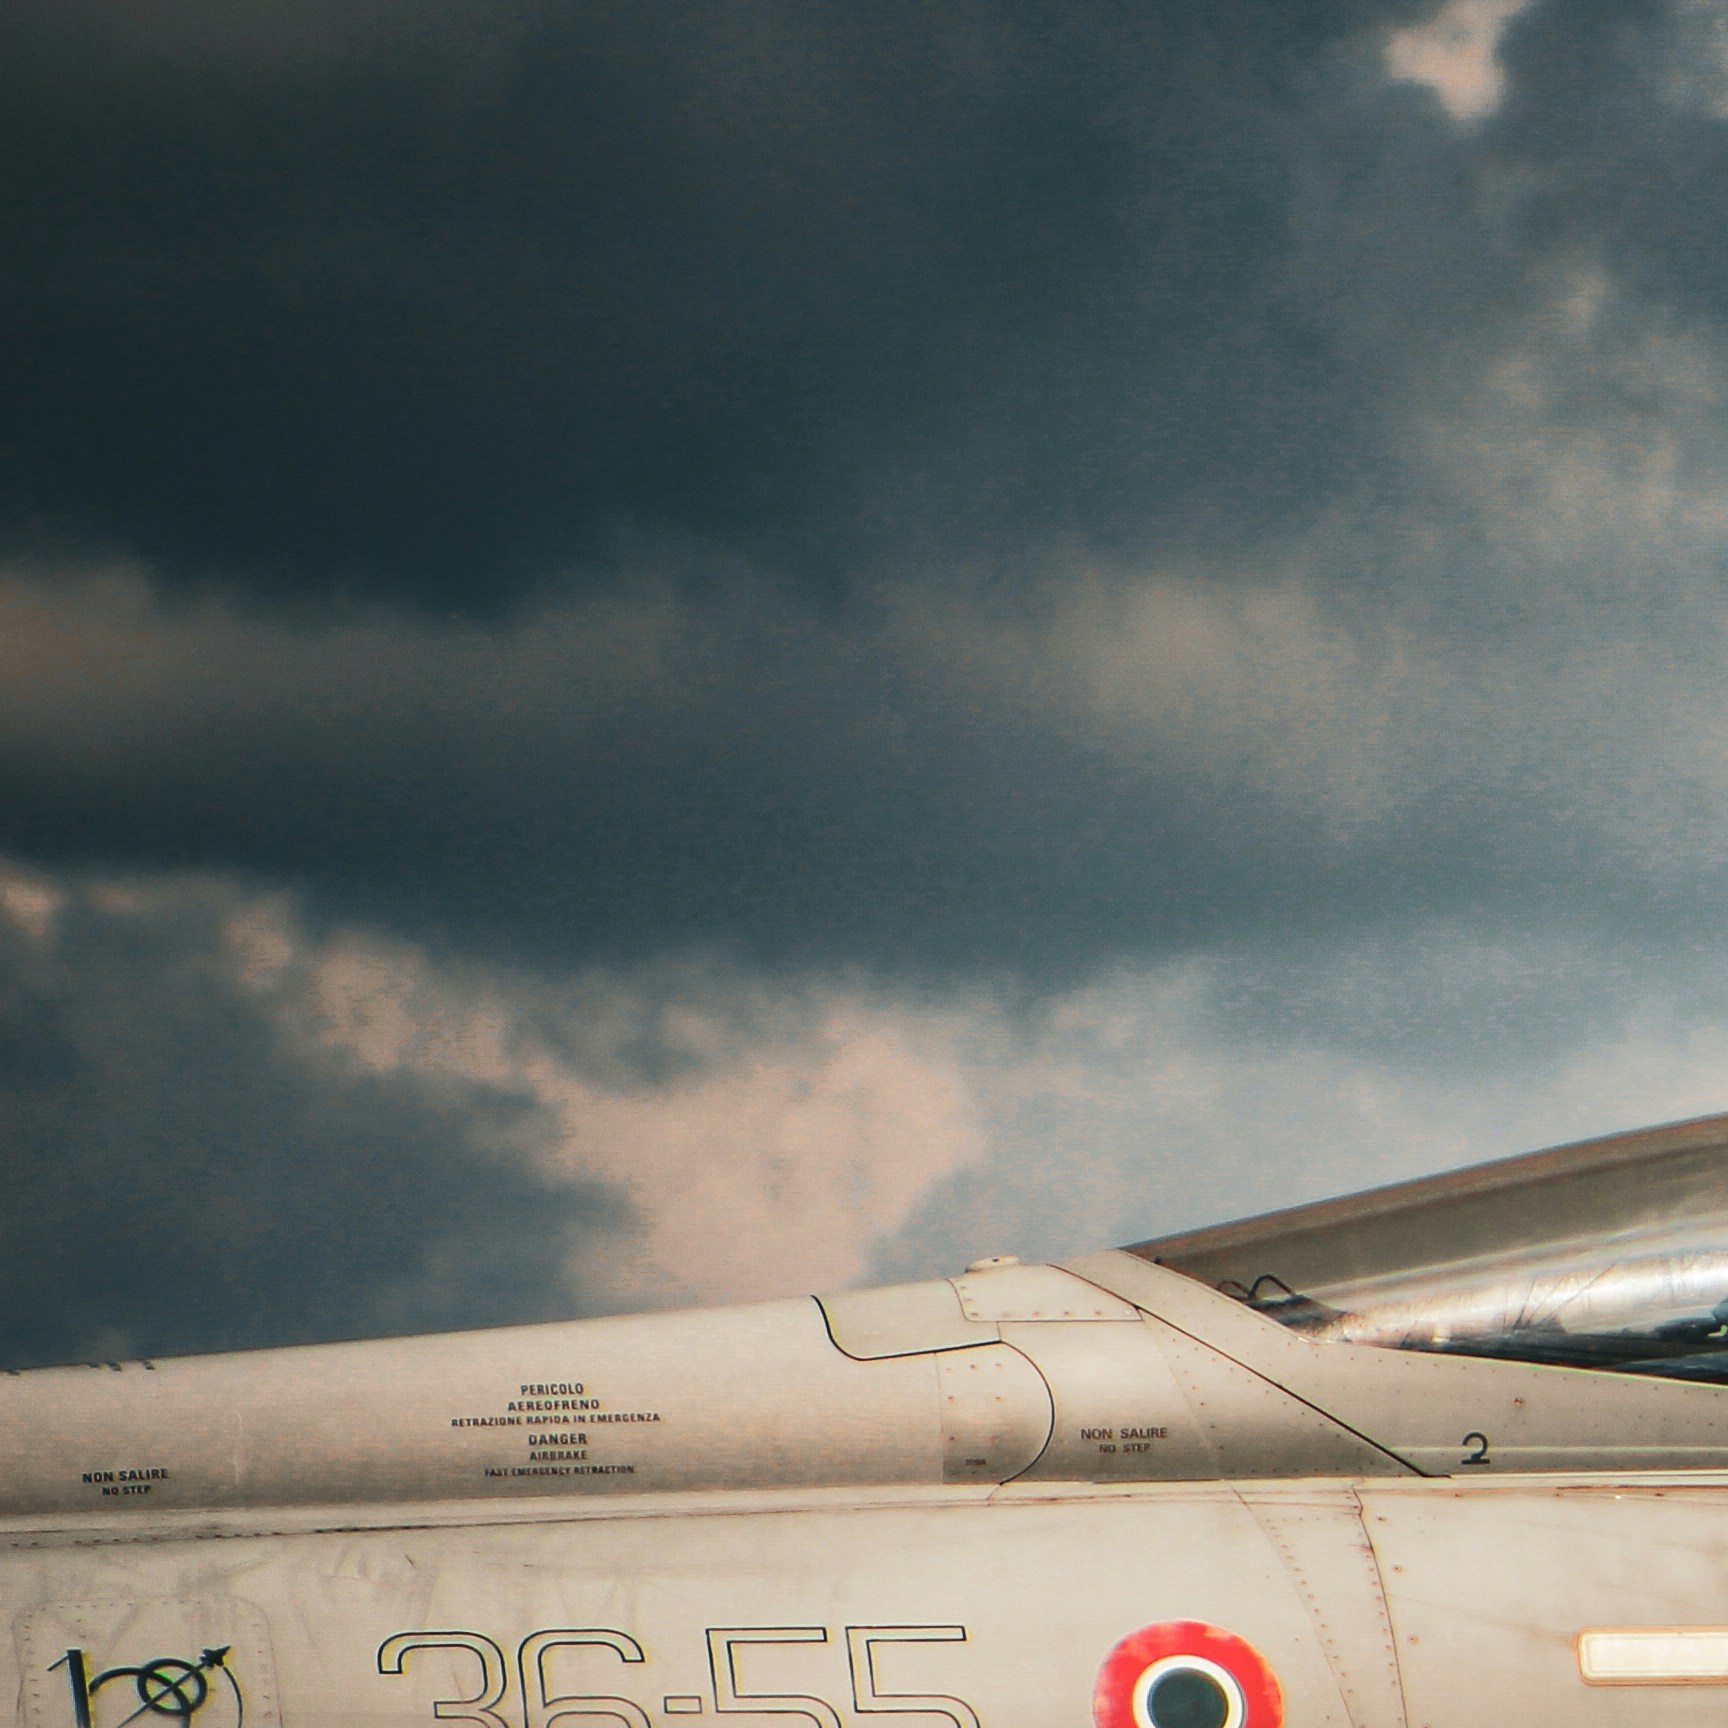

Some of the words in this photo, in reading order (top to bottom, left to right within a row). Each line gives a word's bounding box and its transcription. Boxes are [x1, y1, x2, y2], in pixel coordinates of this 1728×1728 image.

[520, 1383, 584, 1396] PERICOLO
[507, 1399, 600, 1412] AEREOFRENO
[451, 1416, 522, 1427] RETRAZIONE
[526, 1415, 570, 1425] RAPIDA
[574, 1414, 586, 1424] IN
[590, 1412, 660, 1423] EMERGENZA
[528, 1433, 587, 1446] DANGER
[1080, 1428, 1112, 1440] NON
[1120, 1427, 1168, 1439] SALIRE
[1099, 1444, 1116, 1453] NO
[1123, 1443, 1151, 1453] STEP
[529, 1449, 588, 1462] AIRBRAKE
[82, 1471, 113, 1483] NON
[118, 1468, 168, 1482] SALIRE
[484, 1466, 507, 1477] FAST
[512, 1465, 570, 1476] EMERGENCY
[574, 1465, 634, 1475] RETRACTION
[102, 1486, 119, 1496] NO
[122, 1485, 151, 1495] STEP
